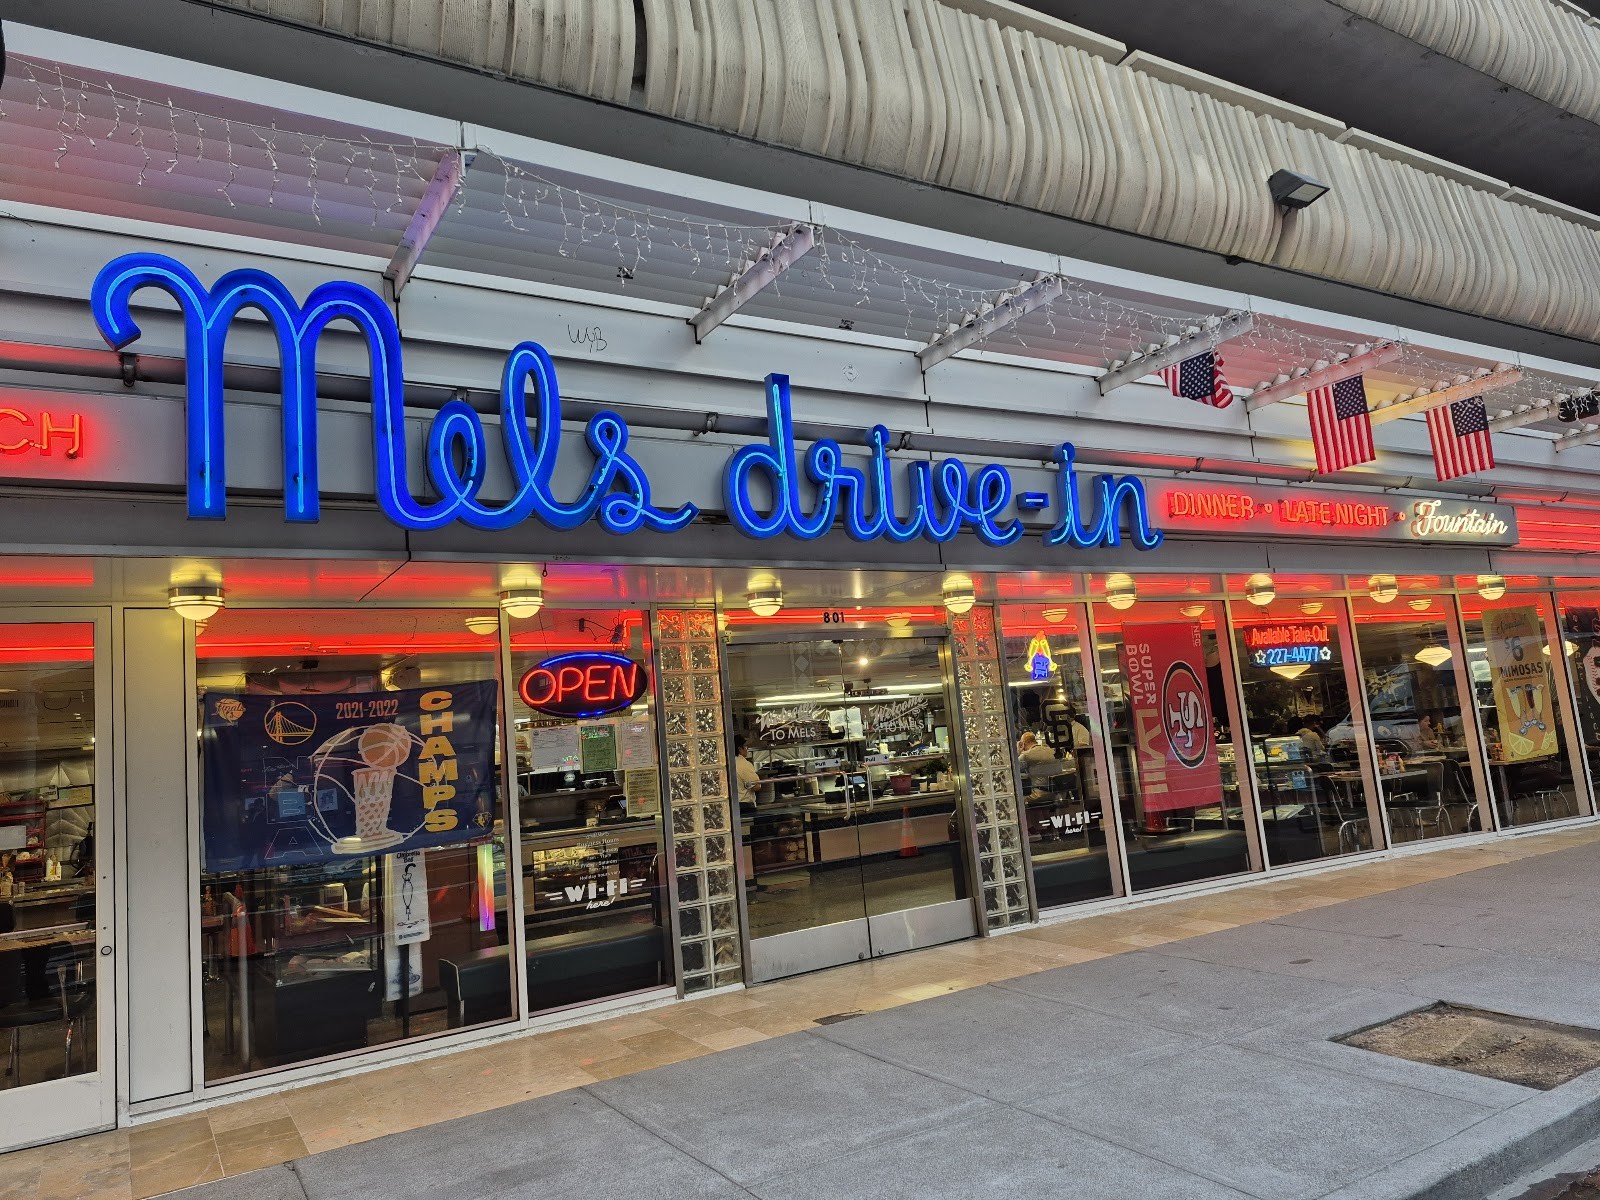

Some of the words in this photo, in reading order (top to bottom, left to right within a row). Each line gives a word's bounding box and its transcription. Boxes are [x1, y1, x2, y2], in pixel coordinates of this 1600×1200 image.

[91, 252, 699, 535] Mels
[723, 373, 1164, 551] drive-in
[1168, 491, 1254, 519] DINNER
[1280, 499, 1331, 524] LATE
[1335, 502, 1389, 526] NIGHT
[1411, 499, 1508, 537] Fountain
[823, 611, 845, 623] 801
[1192, 625, 1201, 647] NFC
[1252, 626, 1290, 645] Available
[1288, 624, 1330, 642] Take-Out
[1267, 647, 1319, 664] 227-4477
[1126, 644, 1144, 705] BOWL
[1139, 643, 1157, 705] SUPER
[1500, 661, 1544, 679] MIMOSAS
[522, 663, 637, 705] OPEN
[335, 699, 399, 720] 2021-2022
[869, 693, 928, 724] Welcome
[770, 728, 786, 741] TO
[787, 727, 817, 739] MELS
[899, 718, 925, 731] MELS
[418, 690, 459, 833] CHAMPS
[1136, 708, 1169, 794] LVIII
[1050, 811, 1091, 829] WI-FI
[564, 877, 629, 903] WI-FI
[585, 897, 616, 910] here!
